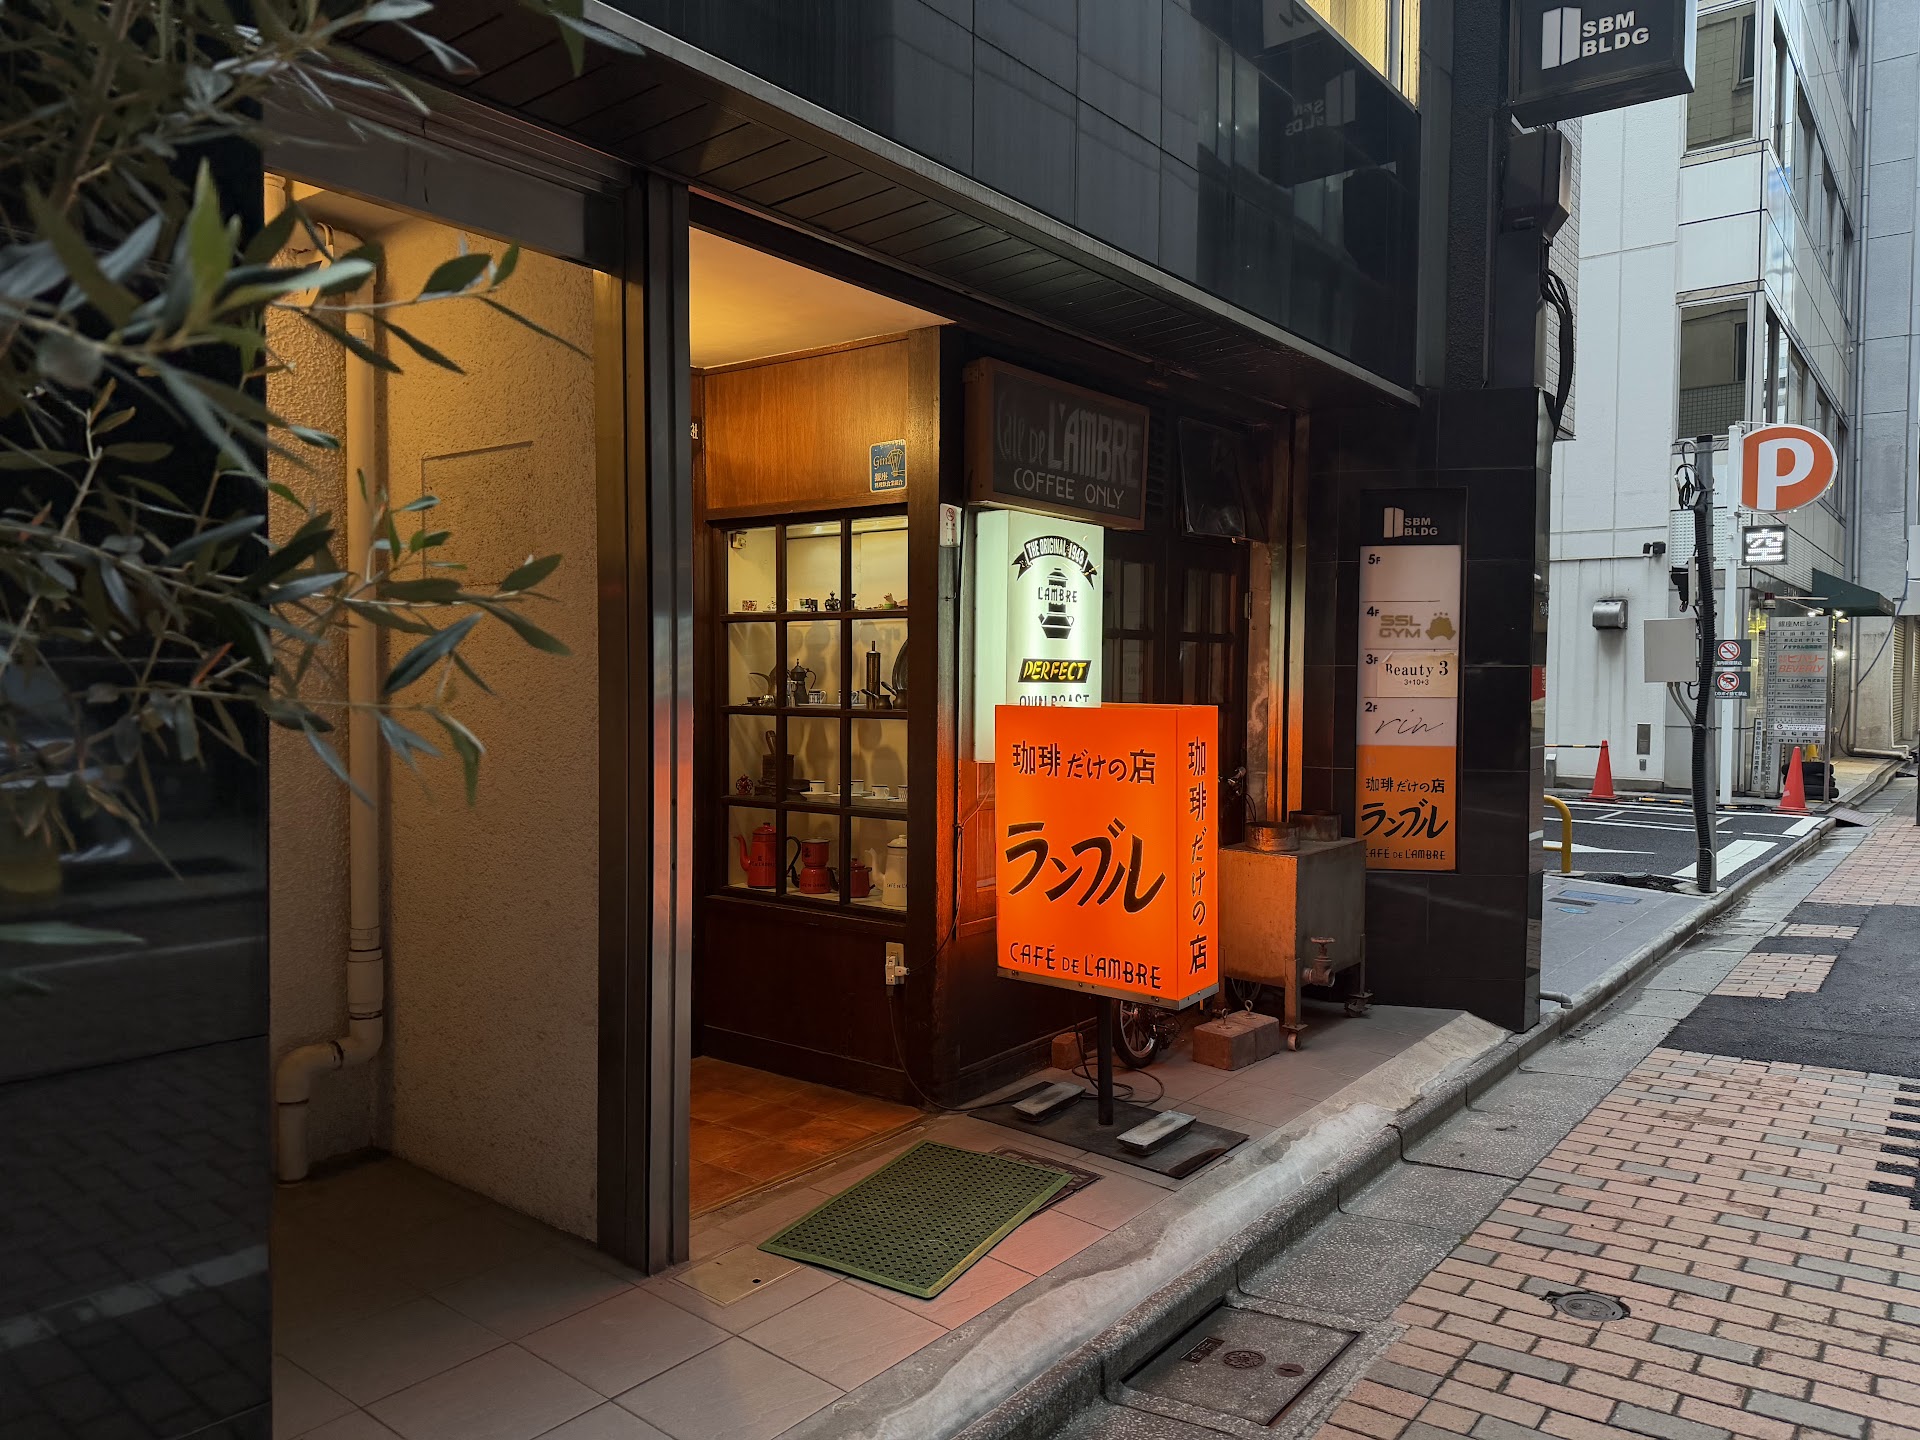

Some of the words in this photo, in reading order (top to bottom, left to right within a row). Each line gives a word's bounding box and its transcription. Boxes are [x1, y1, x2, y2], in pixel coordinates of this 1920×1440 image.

[1582, 10, 1635, 38] SBM
[1582, 27, 1649, 58] BLDG
[1048, 400, 1140, 488] L'AMBRE
[1756, 437, 1815, 510] P
[1014, 467, 1075, 500] COFFEE
[1085, 484, 1124, 510] ONLY
[1404, 517, 1431, 526] SBM
[1404, 527, 1438, 536] BLDG
[1026, 540, 1040, 558] THE
[1039, 537, 1067, 557] ORIGINAL
[1745, 529, 1785, 563] 空
[1367, 554, 1381, 565] 5F
[1038, 586, 1078, 603] L'AMBRE
[1366, 606, 1379, 617] 4F
[1380, 614, 1421, 626] SSL
[1379, 628, 1421, 638] GYM
[1023, 661, 1087, 680] PERFECT
[1366, 654, 1379, 664] 3F
[1439, 660, 1449, 676] 3
[1365, 701, 1378, 712] 2F
[1012, 740, 1156, 784] 珈琲だけの店
[1365, 776, 1445, 793] 珈琲だけの店
[1361, 798, 1449, 839] ランブル
[1005, 817, 1167, 913] ランブル
[1188, 736, 1208, 976] 珈琲だけの店
[1405, 849, 1446, 860] L'AMBRE
[1010, 941, 1056, 971] CAFÉ
[1062, 956, 1080, 975] DE
[1084, 953, 1163, 990] L'AMBRE
